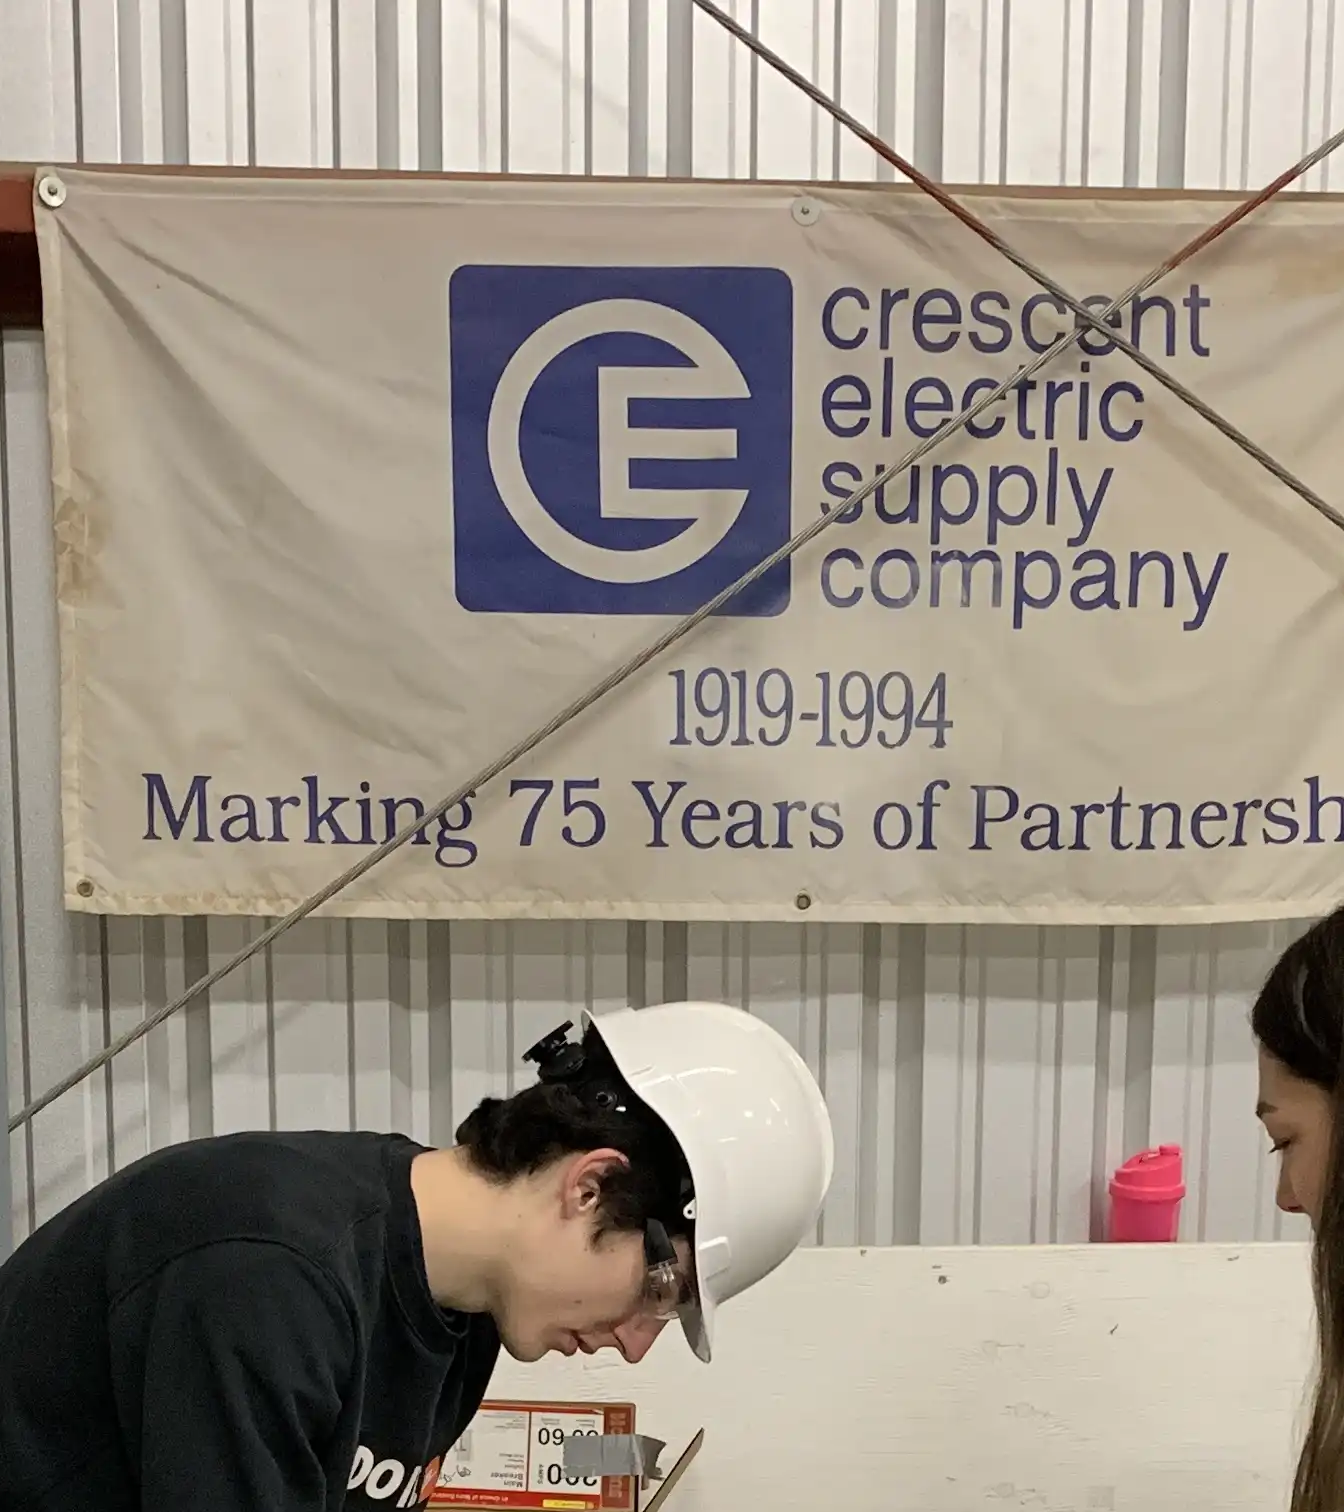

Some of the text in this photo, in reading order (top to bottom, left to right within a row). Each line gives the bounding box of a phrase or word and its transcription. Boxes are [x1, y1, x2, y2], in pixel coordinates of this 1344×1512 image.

[822, 283, 1210, 357] crescent
[822, 358, 1145, 443] electric
[819, 447, 1113, 548] supply
[821, 547, 1228, 631] company
[669, 667, 953, 748] 1919-1994
[141, 773, 478, 868] Marking
[509, 778, 606, 847] 75
[631, 779, 844, 849] Years
[873, 780, 950, 850] of
